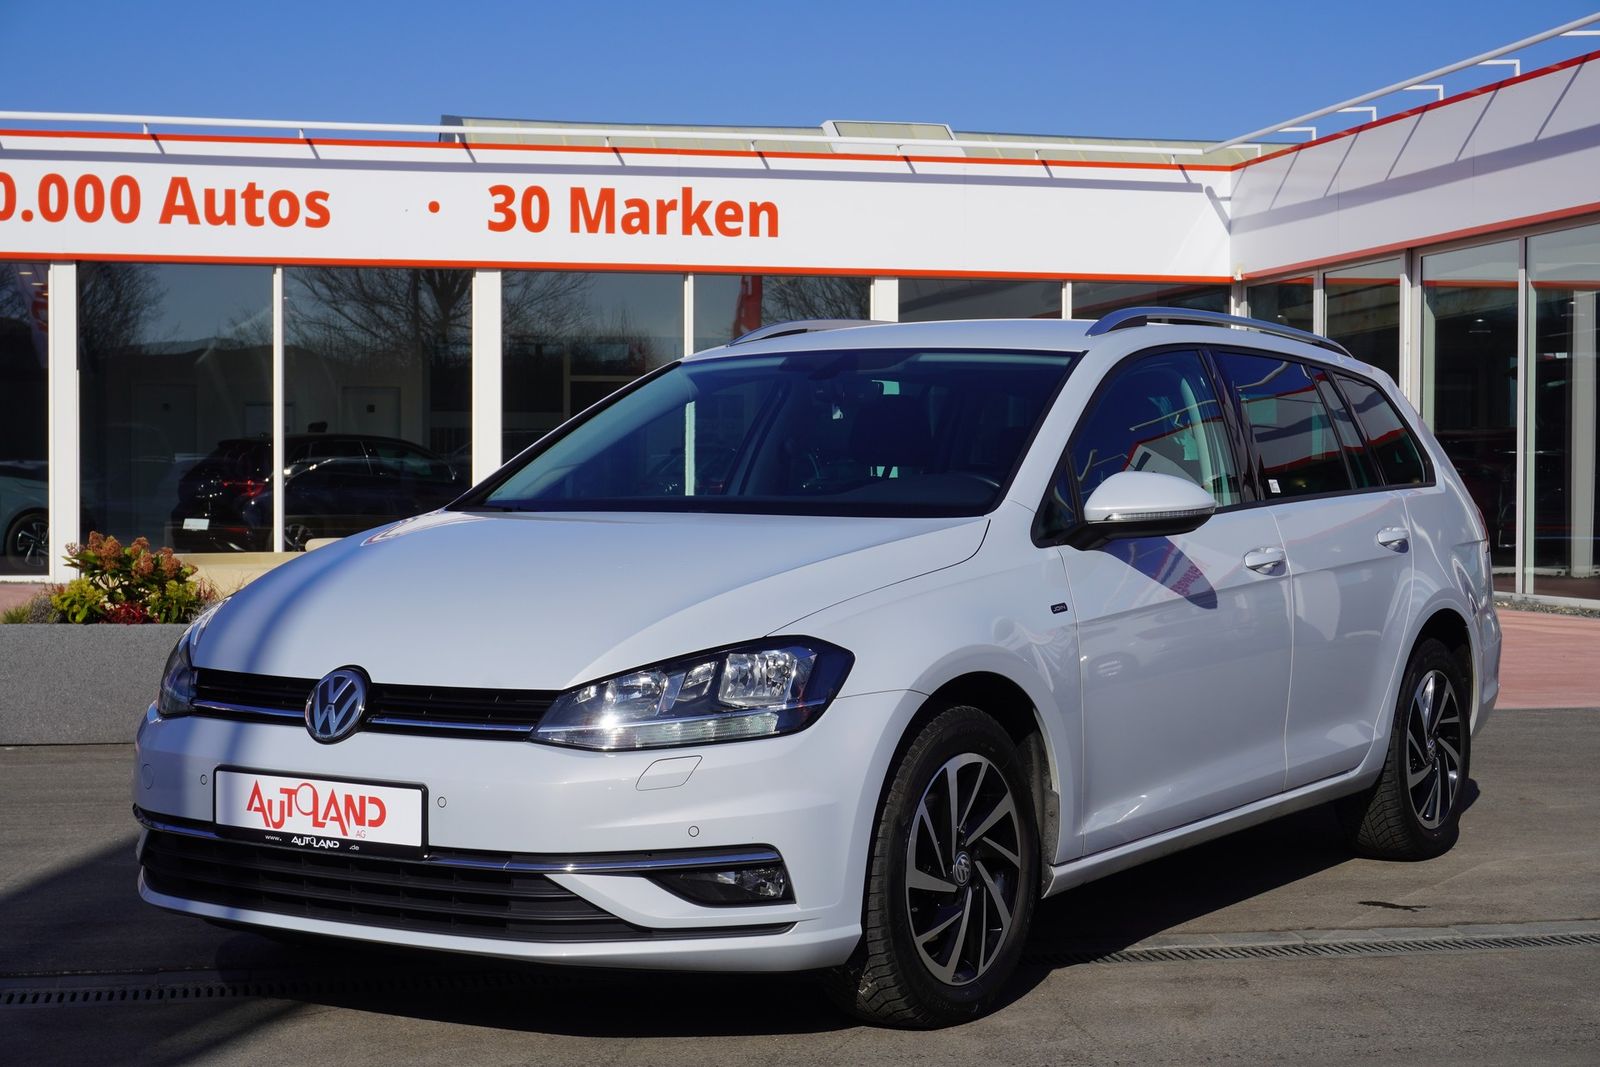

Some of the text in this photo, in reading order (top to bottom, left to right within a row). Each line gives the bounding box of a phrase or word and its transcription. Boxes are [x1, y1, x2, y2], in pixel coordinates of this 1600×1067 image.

[158, 176, 331, 228] Autos
[487, 184, 550, 234] 30
[569, 187, 780, 238] Marken
[312, 669, 366, 740] VW
[355, 830, 367, 839] AG
